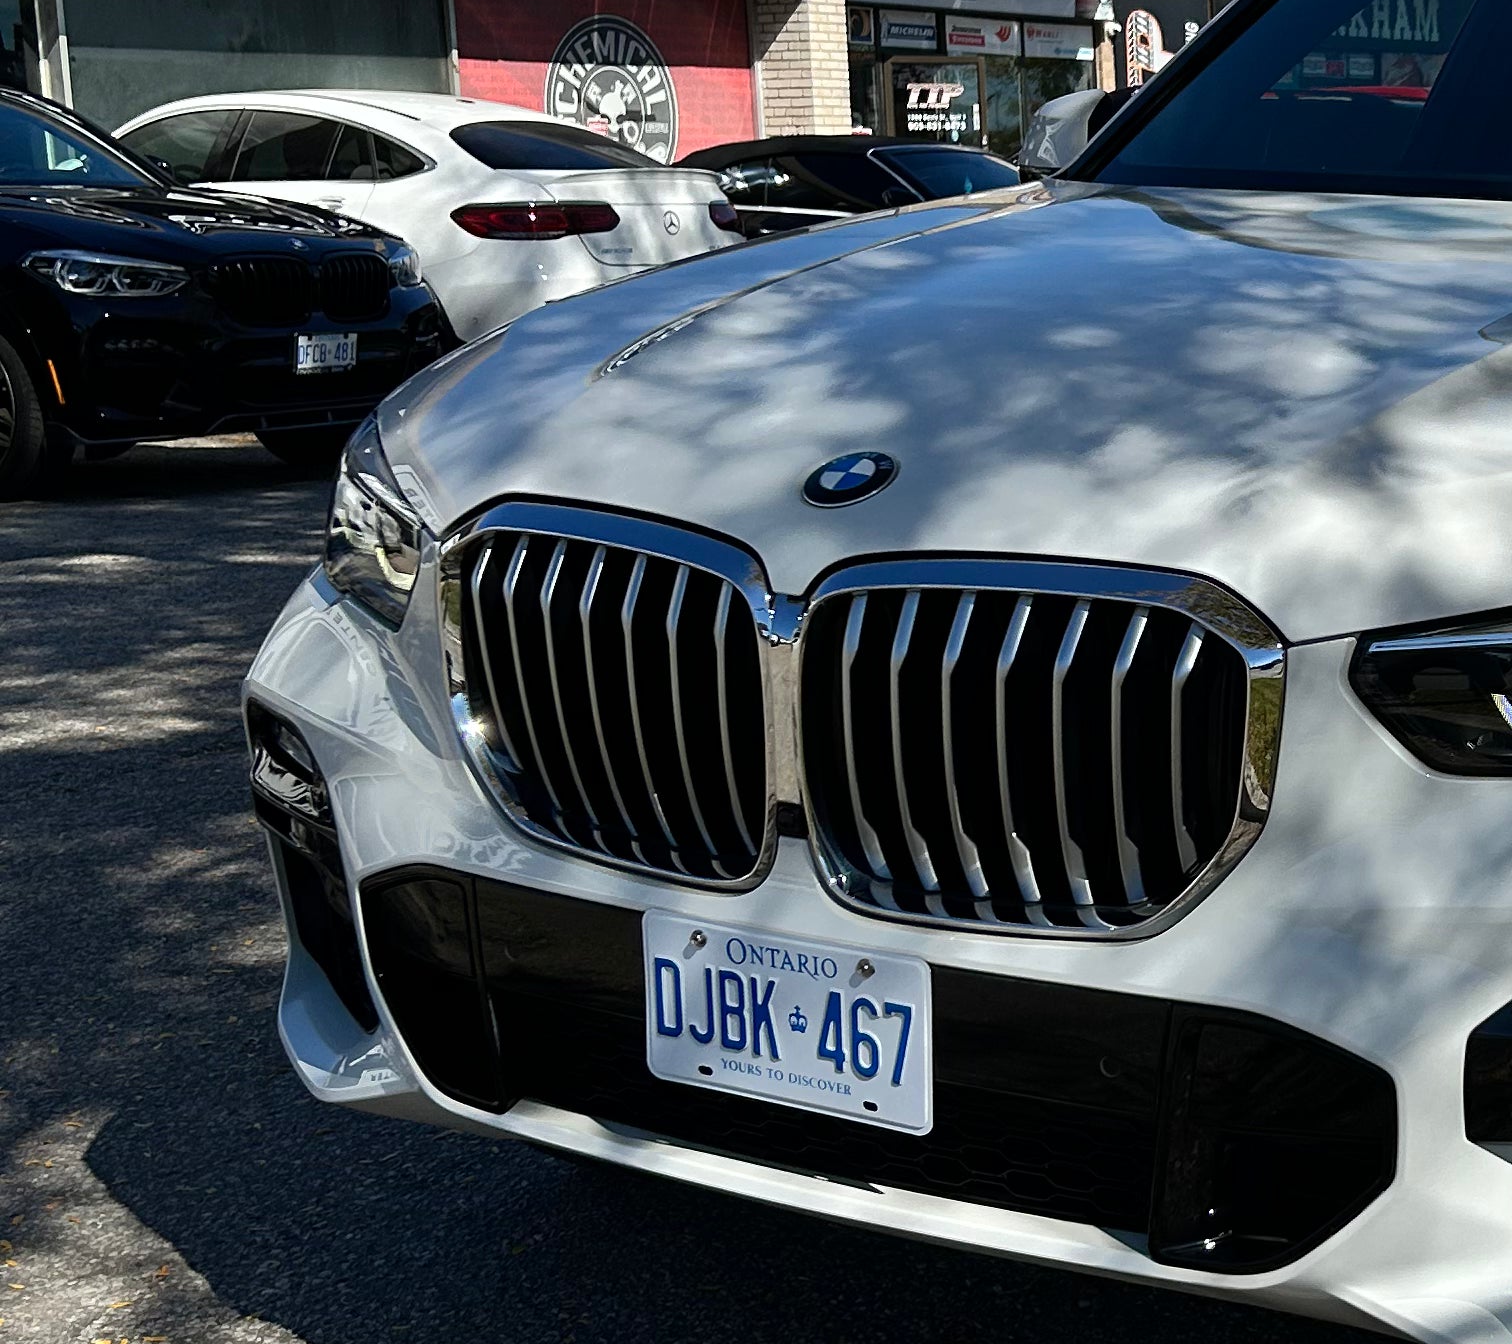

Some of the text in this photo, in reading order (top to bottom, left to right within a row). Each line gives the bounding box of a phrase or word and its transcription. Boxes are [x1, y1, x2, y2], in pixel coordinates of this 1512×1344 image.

[555, 30, 668, 116] CHEMICAL
[298, 342, 355, 364] DFCB 481
[726, 938, 838, 980] ONTARIO
[654, 957, 912, 1086] DJBK 467
[721, 1058, 852, 1096] YOURS TO DISCOVER
